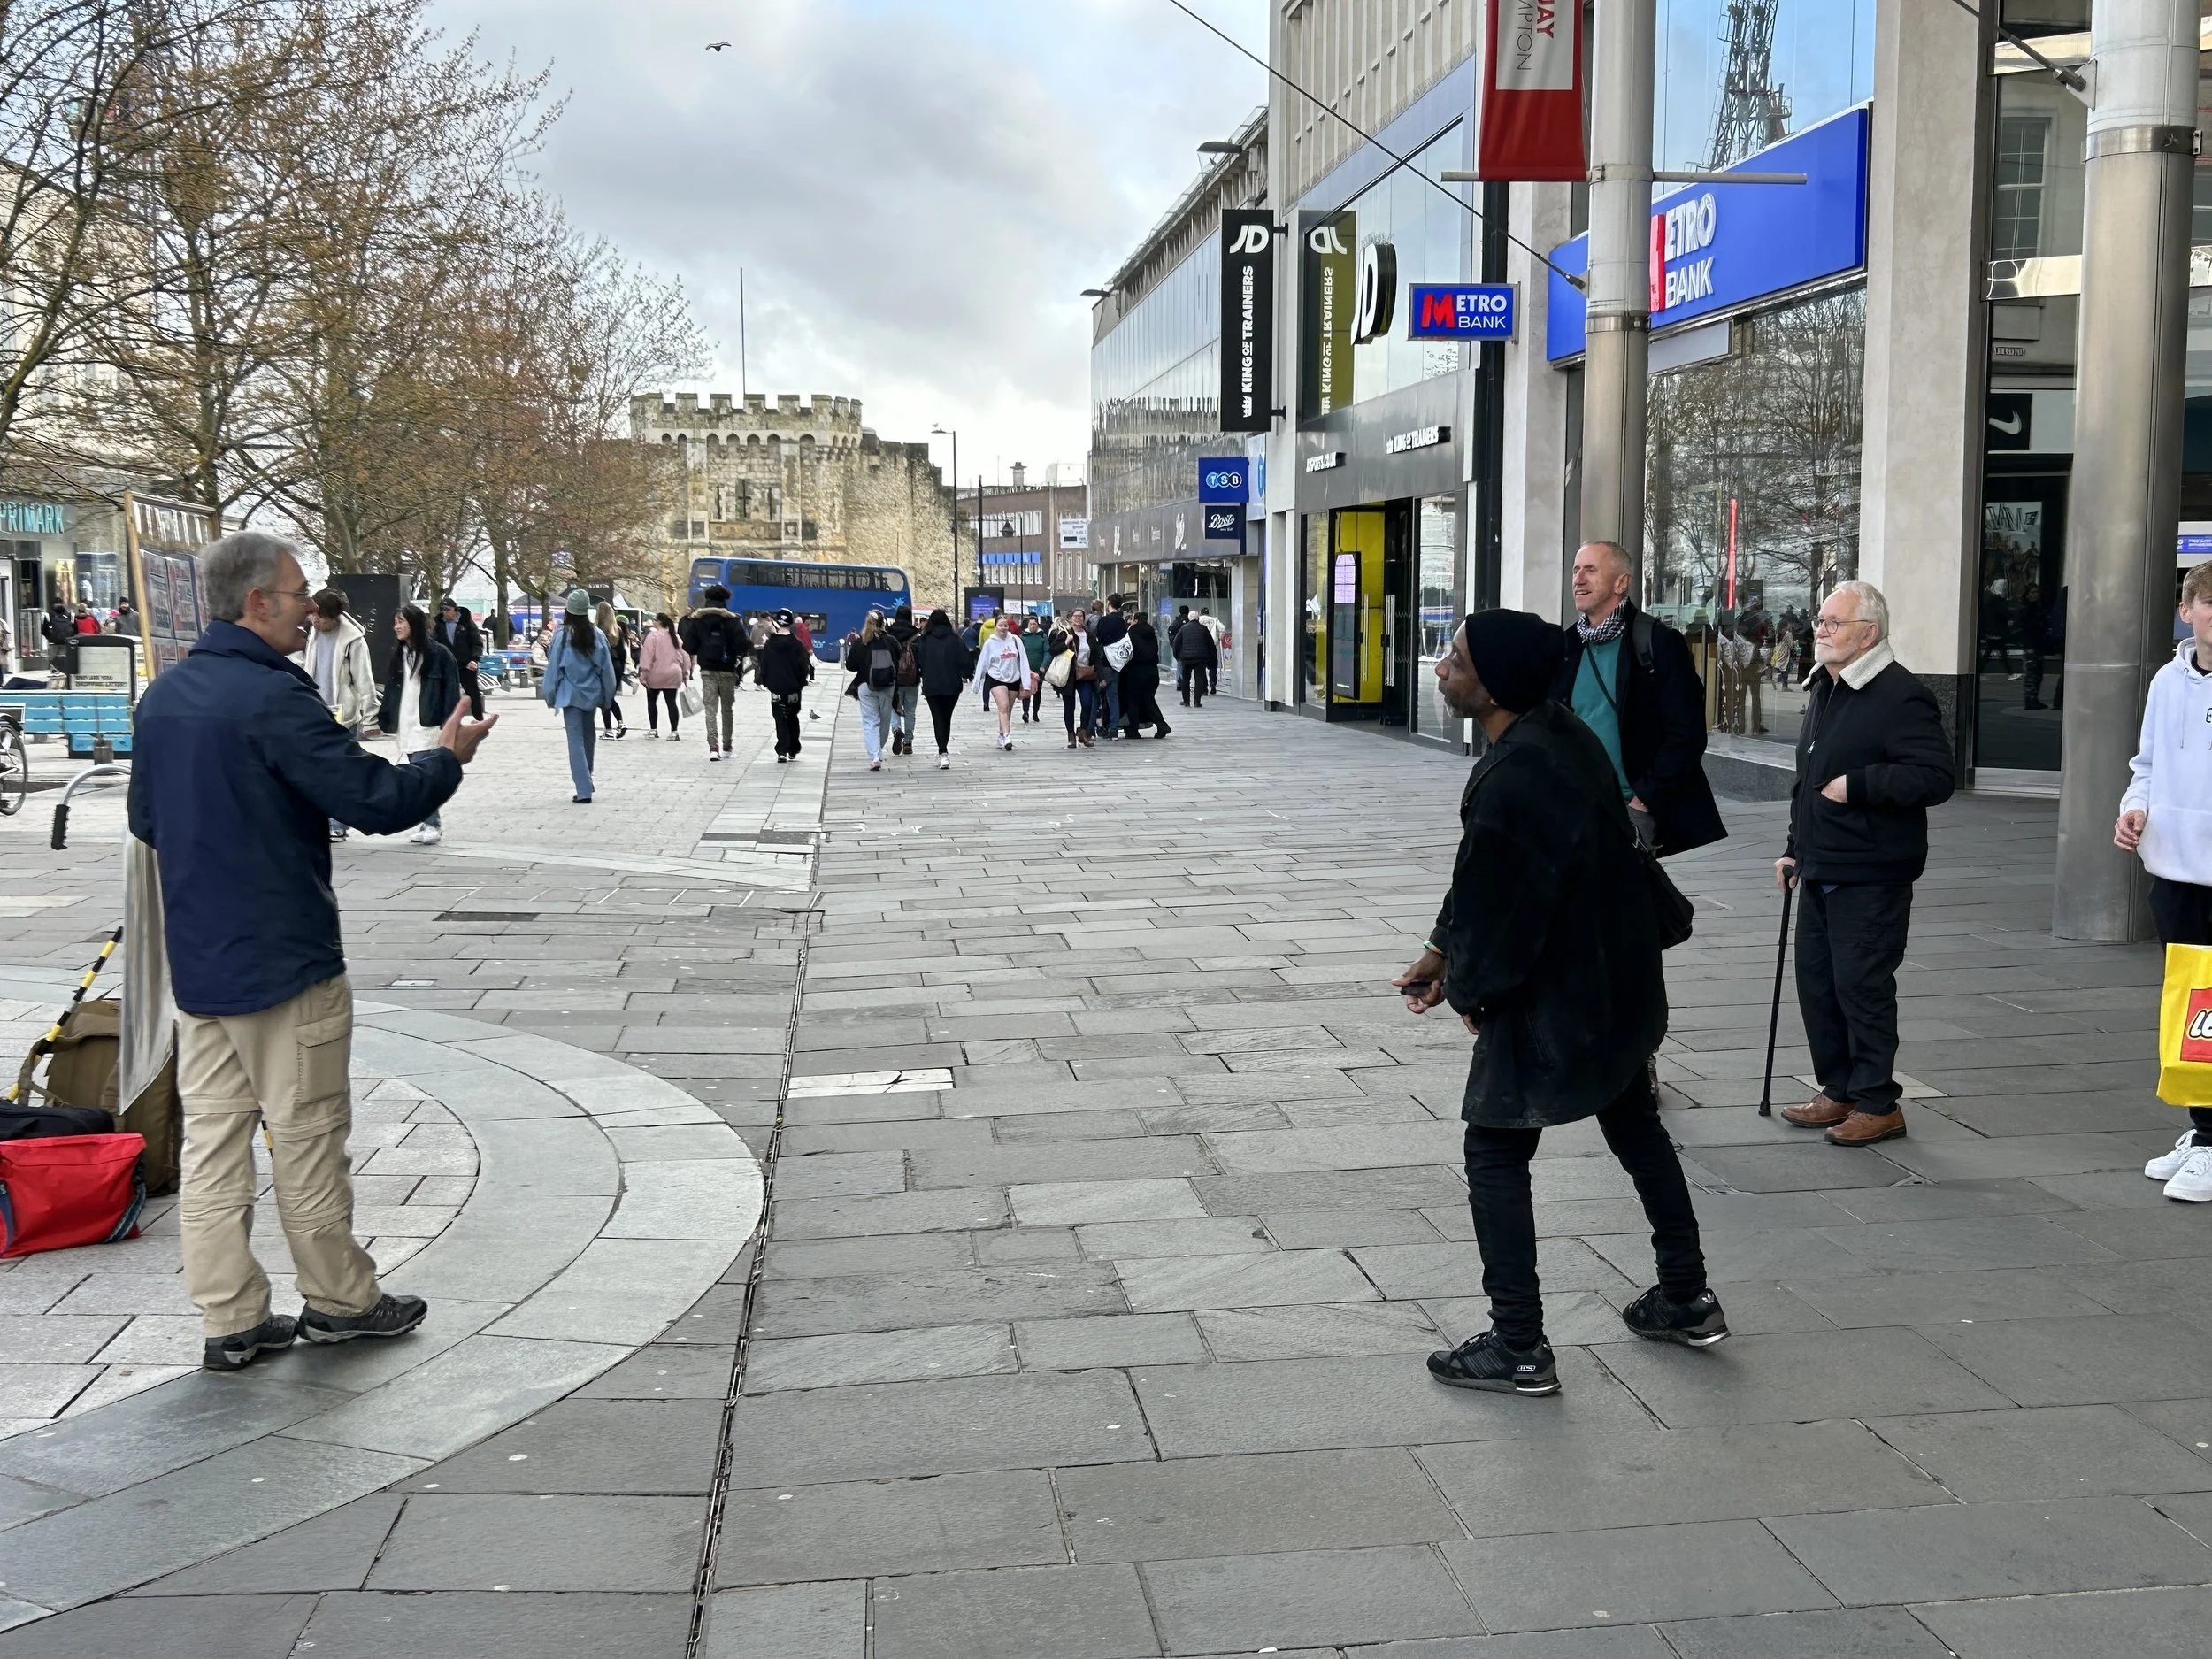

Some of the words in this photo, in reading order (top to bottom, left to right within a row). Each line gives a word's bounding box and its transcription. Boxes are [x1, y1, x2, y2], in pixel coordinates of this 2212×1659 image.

[1229, 224, 1270, 254] JD
[1665, 257, 1715, 310] BANK
[1242, 265, 1254, 340] TRAINERS
[1420, 293, 1508, 328] METRO
[1458, 315, 1506, 329] BANK
[1242, 342, 1253, 356] OF
[1241, 356, 1253, 393] KING
[1209, 474, 1240, 486] TSB
[0, 502, 65, 534] PRIMARK
